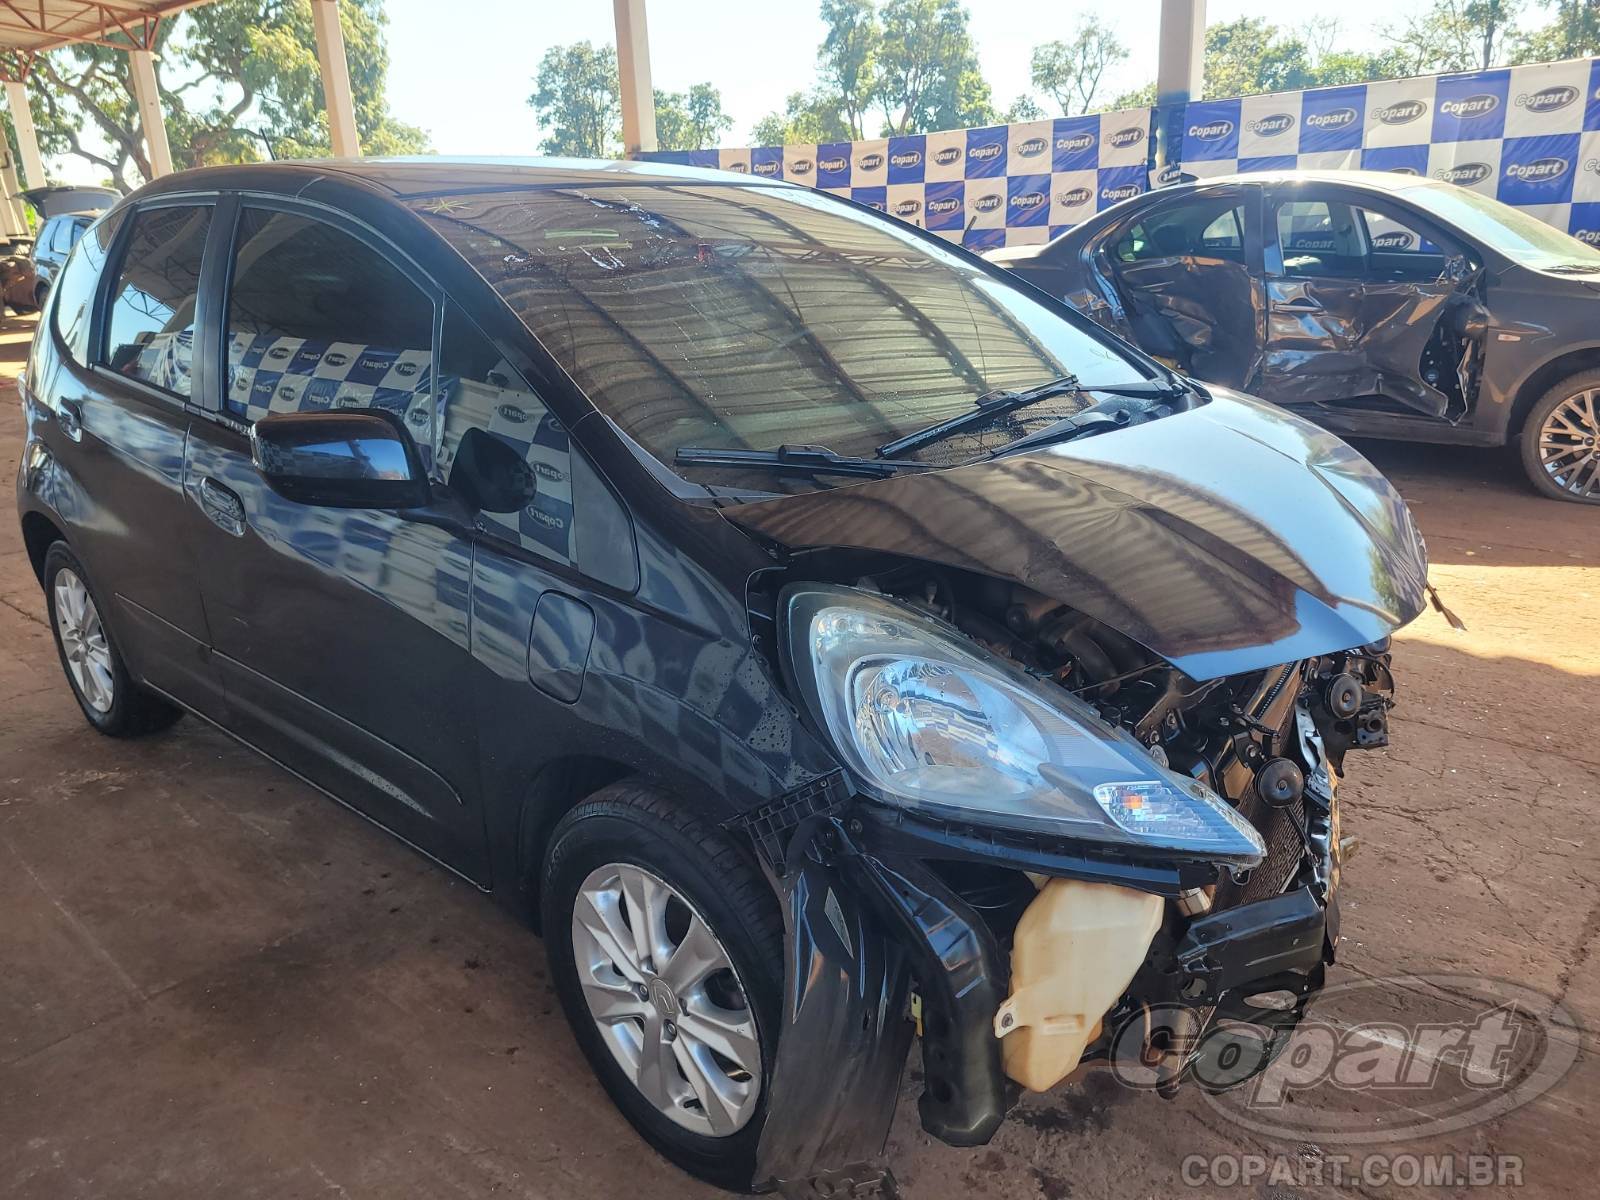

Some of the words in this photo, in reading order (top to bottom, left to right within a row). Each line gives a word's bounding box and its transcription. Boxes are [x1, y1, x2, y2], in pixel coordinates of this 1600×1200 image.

[1515, 89, 1572, 108] Copart
[1371, 103, 1419, 121] Copart
[1440, 97, 1494, 115] Copart
[1247, 116, 1288, 133] Copart
[1306, 111, 1351, 126] Copart
[1188, 123, 1228, 138] Copart
[1057, 136, 1090, 149] Copart
[891, 153, 918, 165] Copart
[969, 147, 999, 159] Copart
[754, 163, 777, 174] Copart
[819, 159, 844, 171] Copart
[1506, 161, 1560, 178] Copart
[1435, 165, 1485, 182] Copart
[1056, 191, 1087, 205] Copart
[1102, 186, 1137, 200] Copart
[928, 199, 956, 212] Copart
[1011, 194, 1041, 208] Copart
